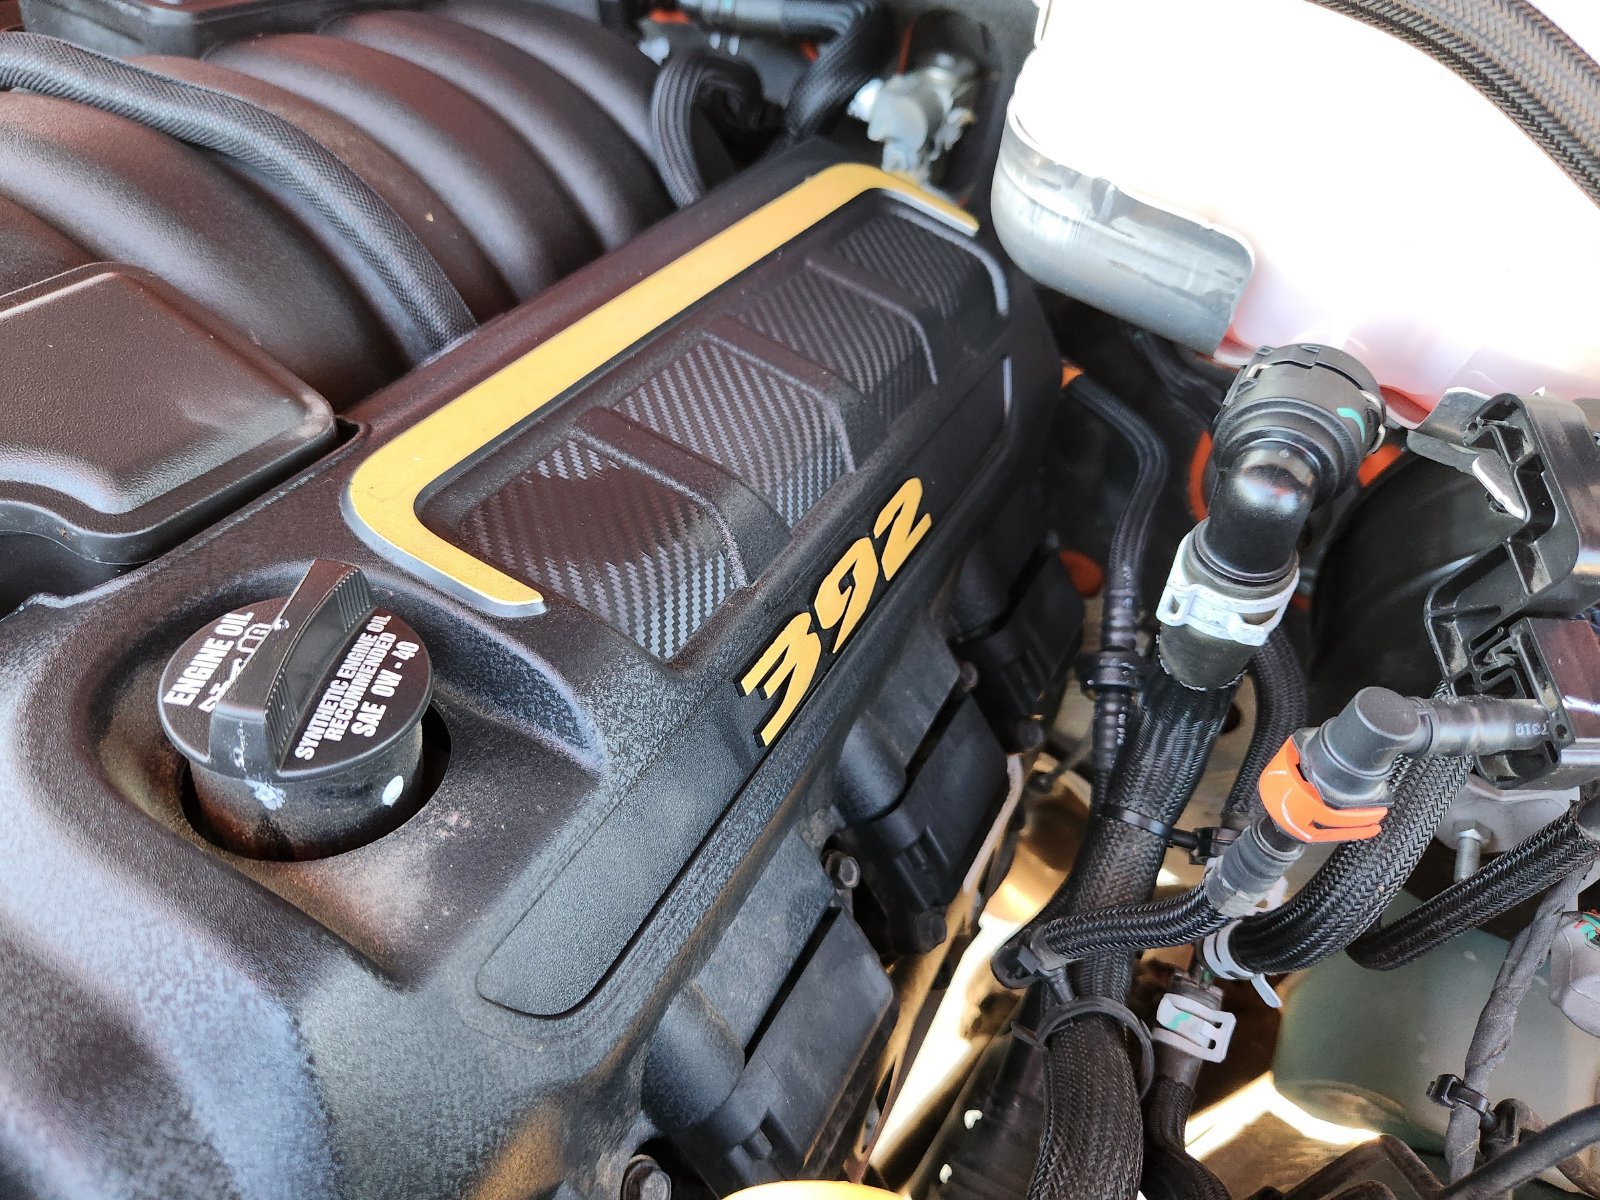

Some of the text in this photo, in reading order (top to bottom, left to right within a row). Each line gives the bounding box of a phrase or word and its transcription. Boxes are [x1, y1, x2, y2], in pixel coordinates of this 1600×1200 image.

[163, 612, 255, 706] ENGINE OIL
[737, 477, 932, 747] 392
[295, 615, 392, 760] SYNTHETIC ENGINE OIL
[323, 632, 397, 741] RECOMMENDED
[351, 701, 387, 737] SAE
